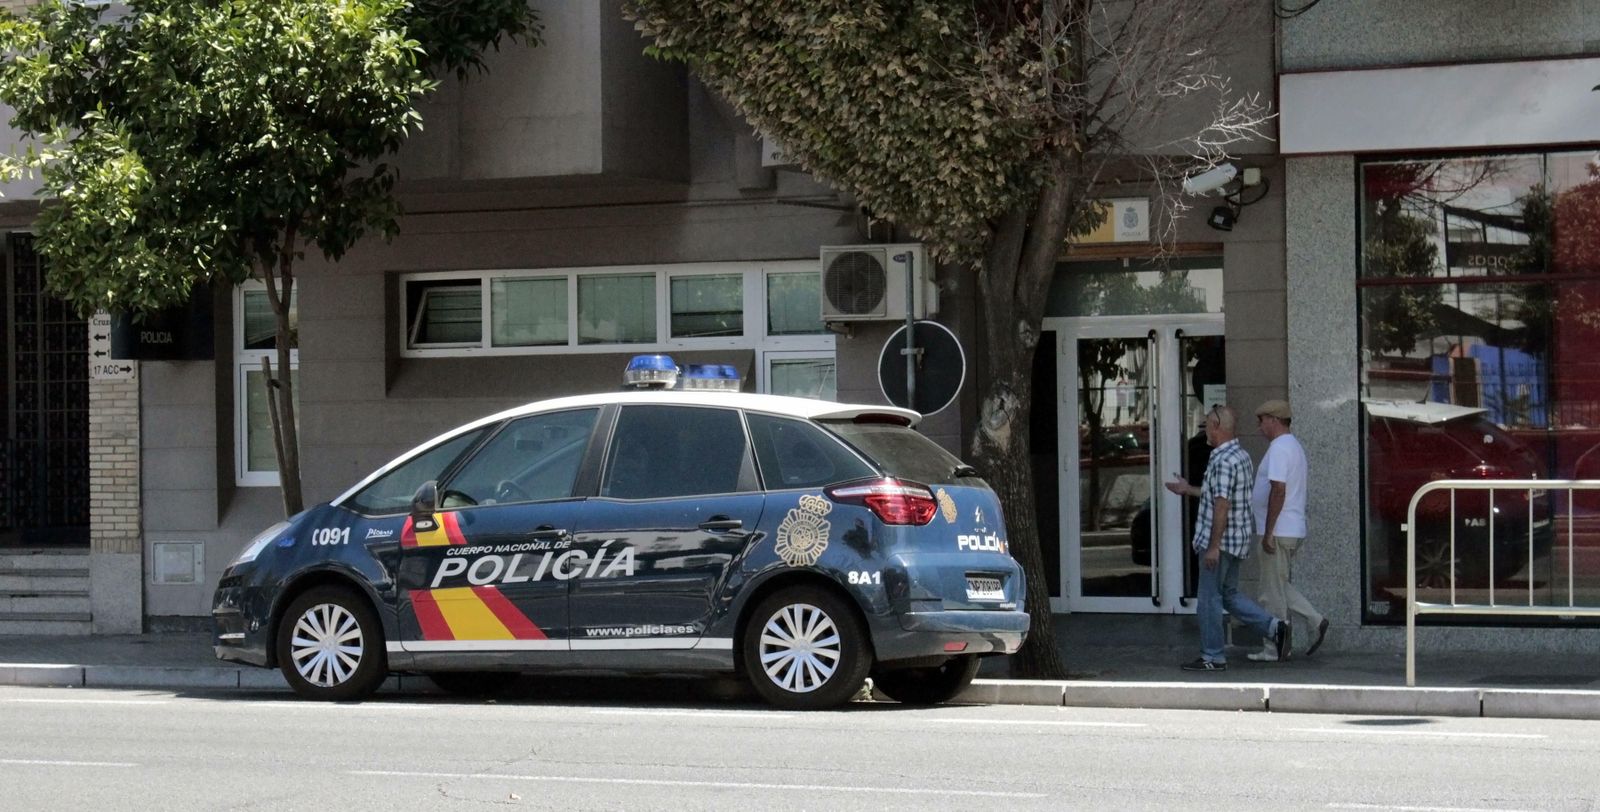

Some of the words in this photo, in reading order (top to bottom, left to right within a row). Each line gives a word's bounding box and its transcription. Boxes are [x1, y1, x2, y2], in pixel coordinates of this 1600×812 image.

[141, 331, 173, 343] POLICIA
[94, 365, 101, 375] 17
[446, 546, 493, 556] CUERPO
[495, 541, 551, 553] NACIONAL
[553, 540, 572, 549] DE
[430, 539, 635, 588] POLICÍA
[847, 570, 881, 585] 8A1
[585, 624, 695, 637] www.policia.es
